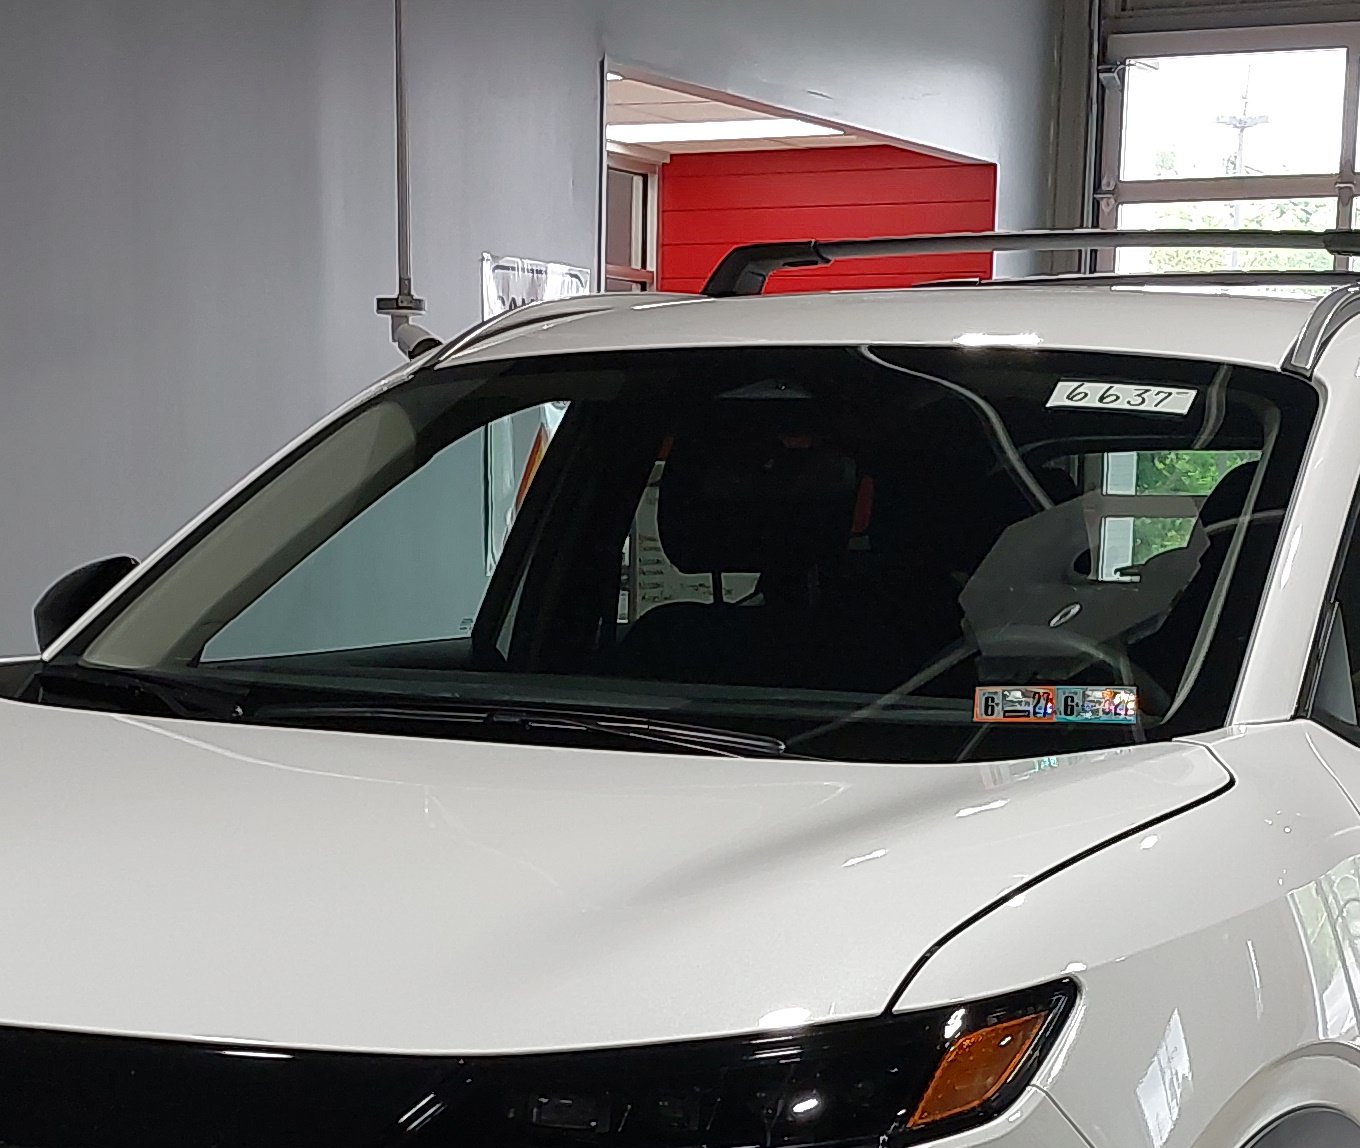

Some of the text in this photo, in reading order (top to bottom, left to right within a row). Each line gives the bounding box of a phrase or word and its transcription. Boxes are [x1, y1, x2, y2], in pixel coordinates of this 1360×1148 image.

[1065, 382, 1174, 408] 6637
[983, 696, 996, 717] 6
[1063, 695, 1076, 717] 6
